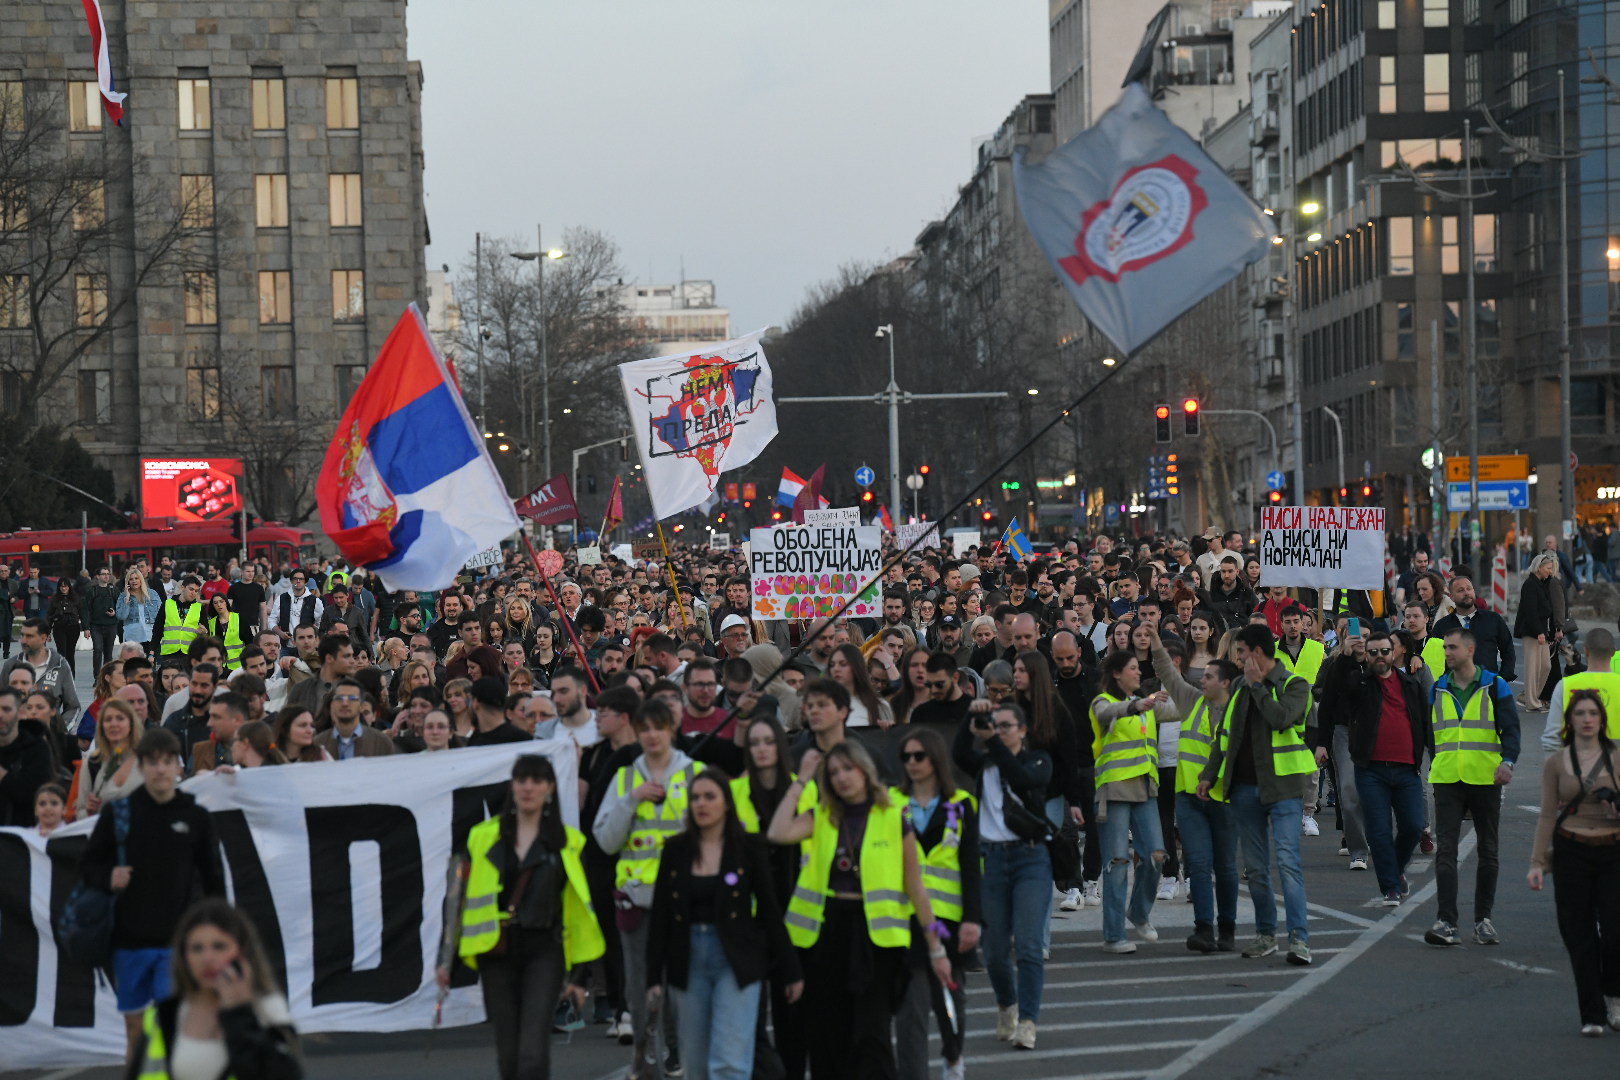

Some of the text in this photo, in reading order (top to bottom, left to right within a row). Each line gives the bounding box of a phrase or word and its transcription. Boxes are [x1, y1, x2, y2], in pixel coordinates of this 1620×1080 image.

[681, 368, 734, 402] НЕМА
[1262, 507, 1385, 531] НИСИ НАДЛЕЖАН
[773, 528, 858, 550] ОБОЈЕНА
[1262, 529, 1348, 550] А НИСИ НИ
[751, 549, 881, 574] РЕВОЛУЦИЈА?
[1264, 547, 1342, 569] НОРМАЛАН
[774, 573, 858, 595] ШАРЕНА
